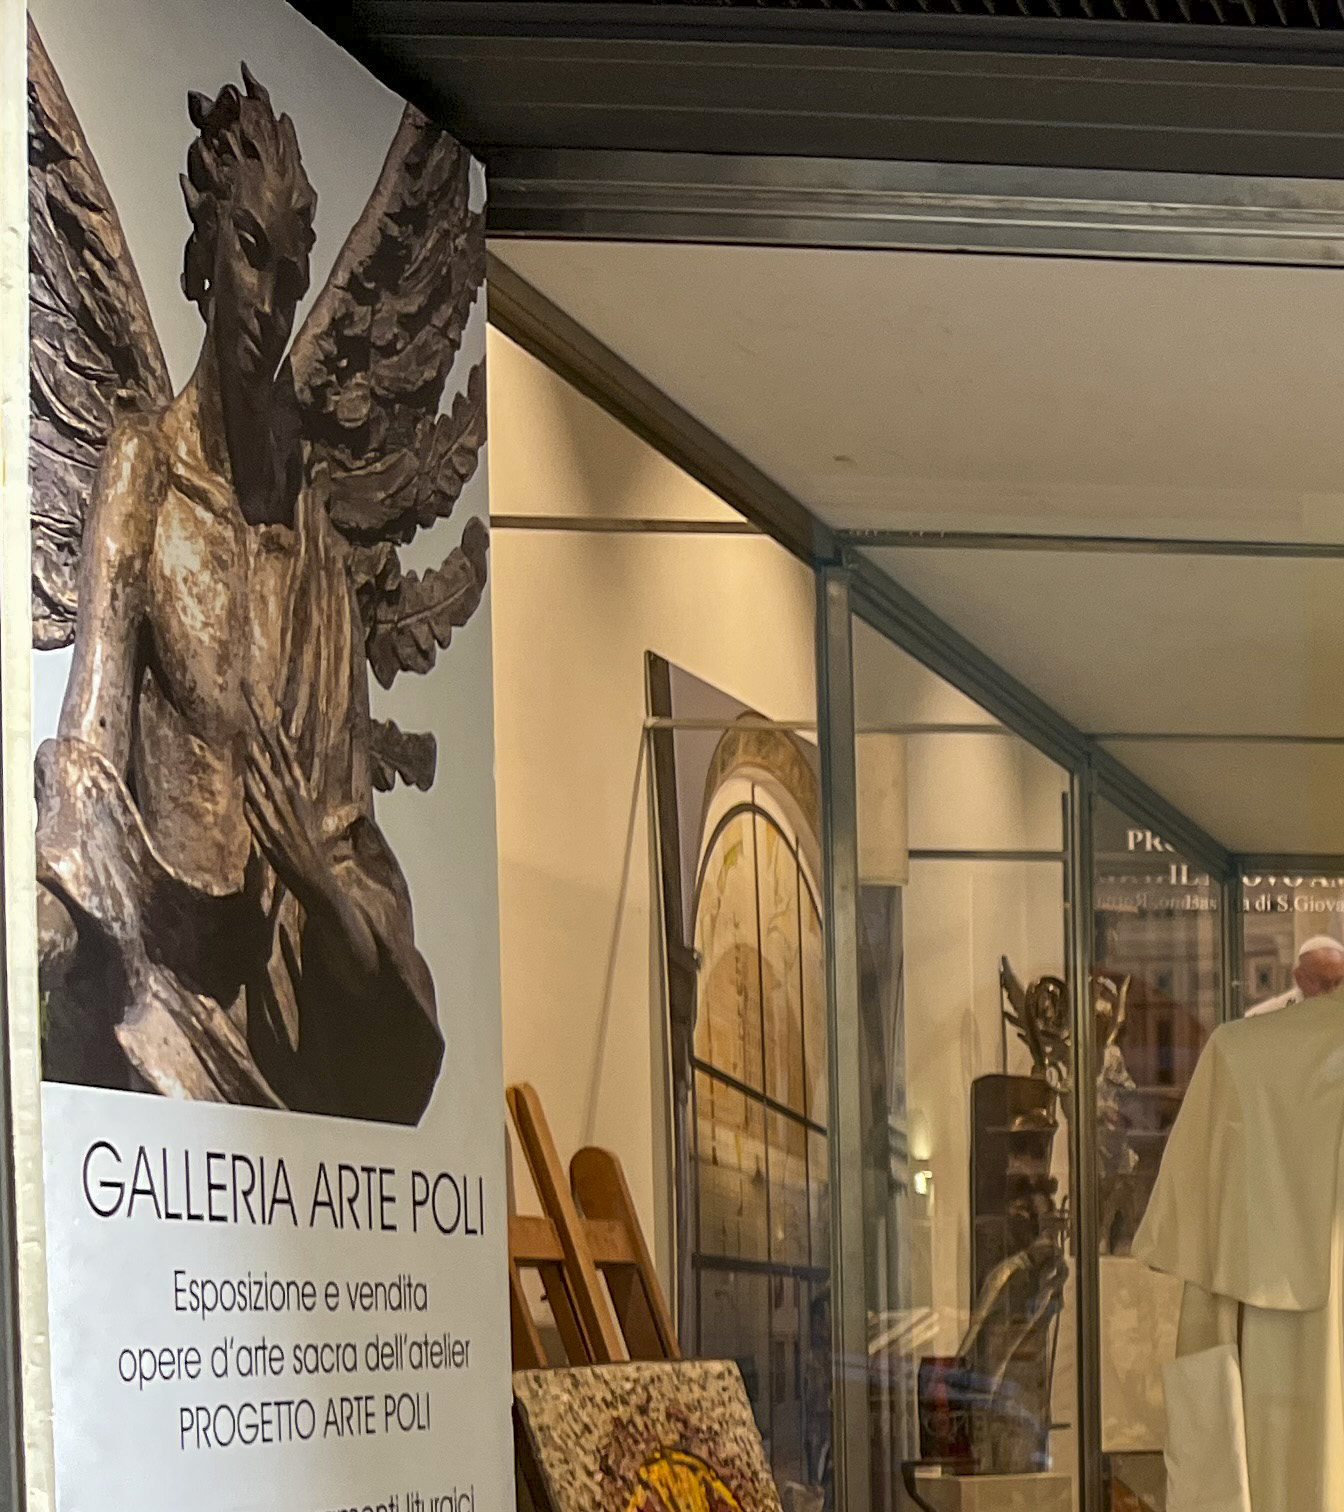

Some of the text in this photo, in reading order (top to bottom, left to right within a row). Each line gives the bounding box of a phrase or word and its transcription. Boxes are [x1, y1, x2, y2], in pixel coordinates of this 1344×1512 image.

[83, 1141, 485, 1236] GALLERIA ARTE POLI
[174, 1270, 428, 1320] Esposizione e vendita
[119, 1334, 470, 1390] opere d'arte sacra dell'atelier
[180, 1392, 431, 1450] PROGETTO ARTE POLI
